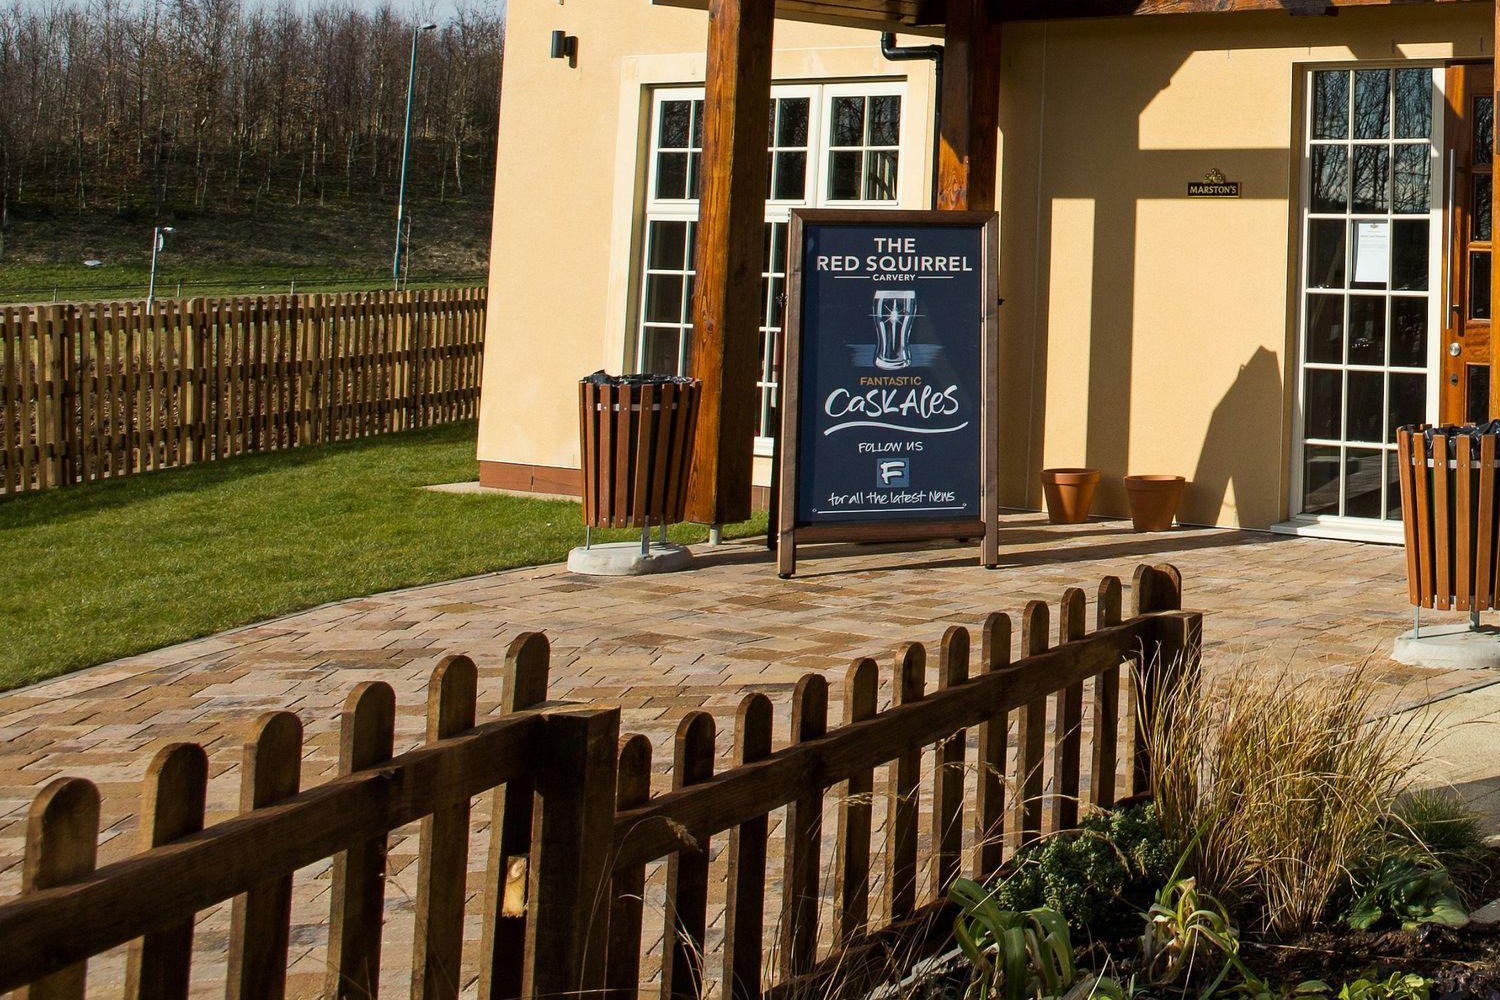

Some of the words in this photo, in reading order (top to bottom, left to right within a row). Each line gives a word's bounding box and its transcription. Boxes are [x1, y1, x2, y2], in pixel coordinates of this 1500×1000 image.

[1189, 185, 1237, 194] MARSTON'S
[873, 237, 916, 253] THE
[816, 255, 860, 272] RED
[866, 255, 973, 272] SQUIRREL
[872, 273, 916, 282] CARVERY
[859, 376, 922, 387] FANTASTIC
[858, 441, 902, 453] FOLLOW
[828, 491, 849, 507] for
[848, 490, 864, 505] all
[865, 490, 889, 505] the
[890, 489, 927, 504] latest
[928, 489, 956, 504] News
